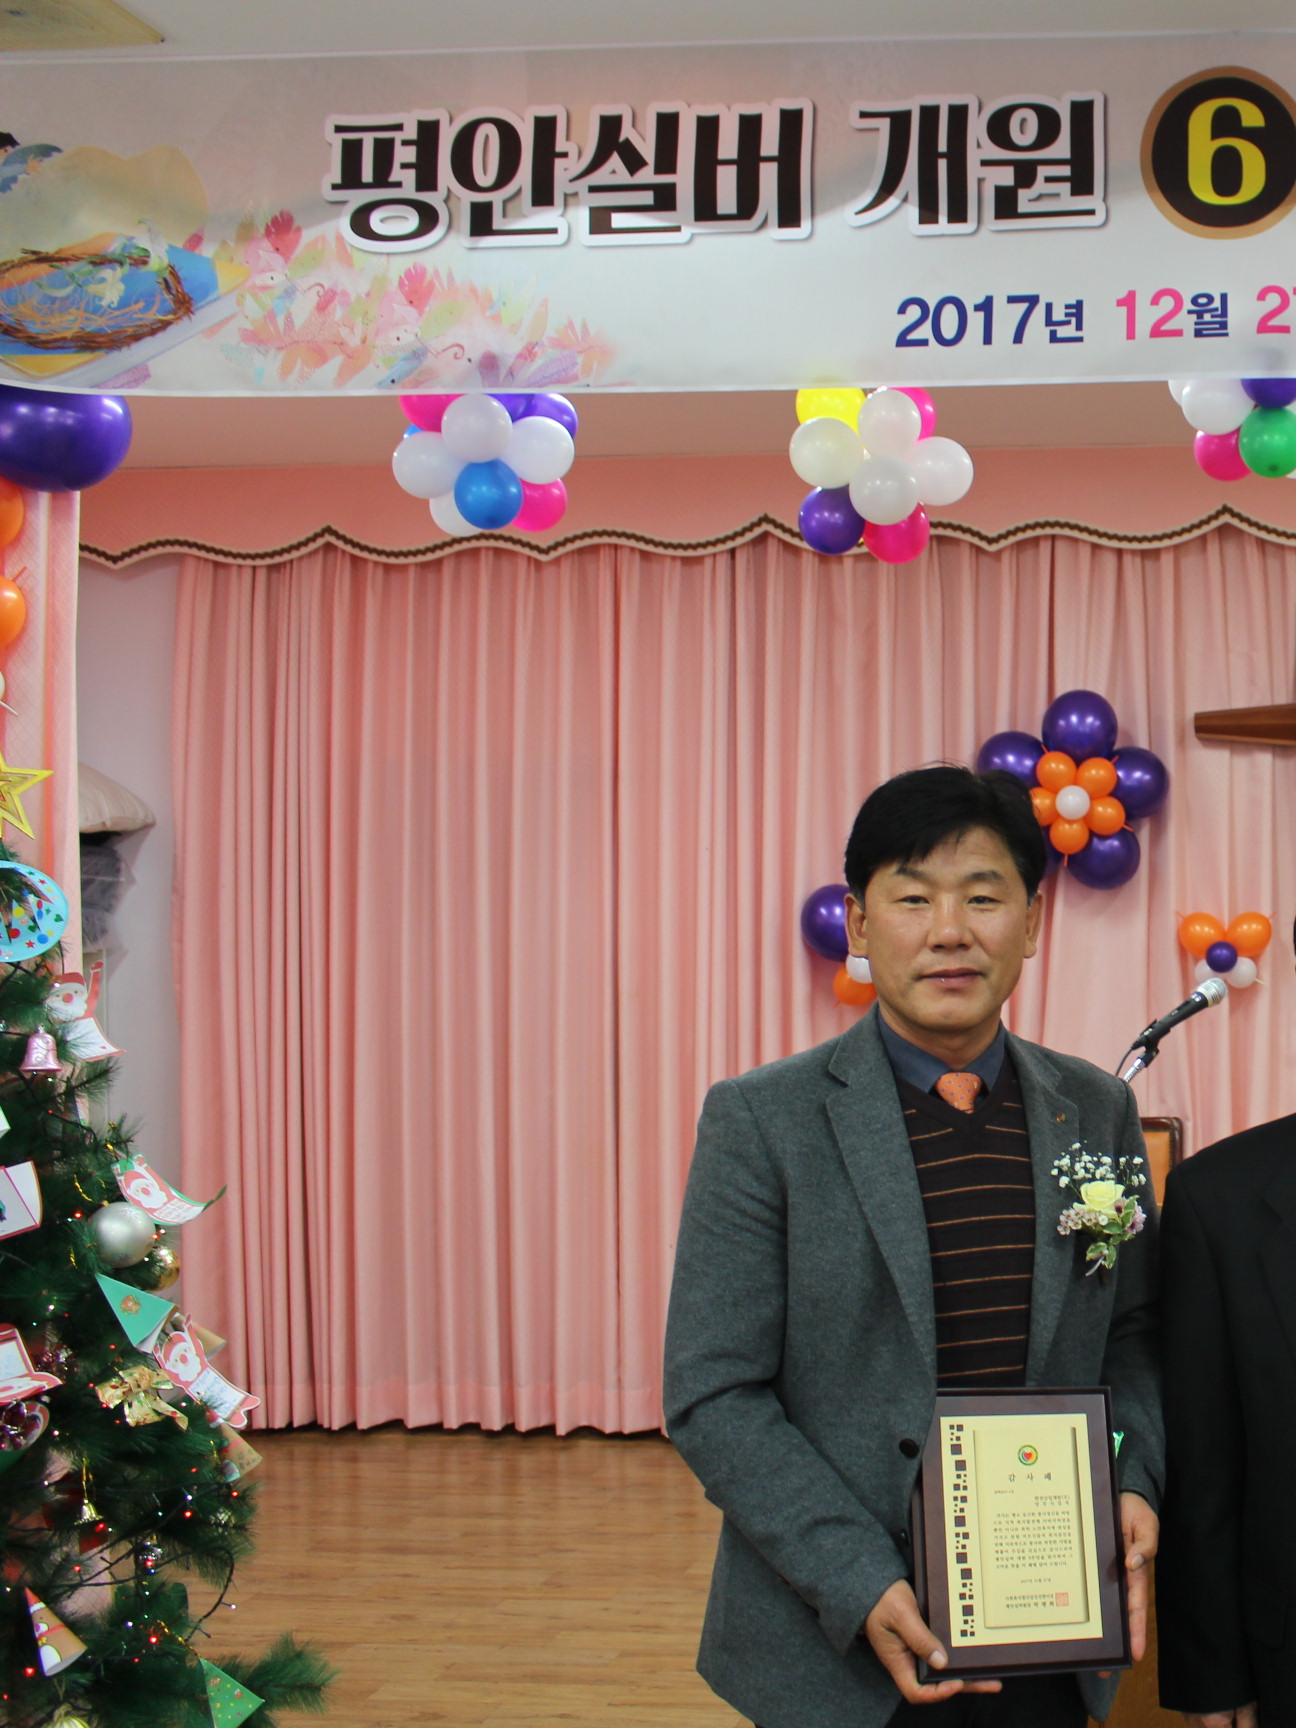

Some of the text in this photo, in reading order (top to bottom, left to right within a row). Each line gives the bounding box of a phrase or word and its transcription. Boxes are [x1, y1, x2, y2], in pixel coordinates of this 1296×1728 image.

[332, 107, 814, 242] 평안실버
[856, 96, 1108, 225] 개원
[895, 293, 1084, 348] 2017년
[1116, 288, 1231, 341] 12월
